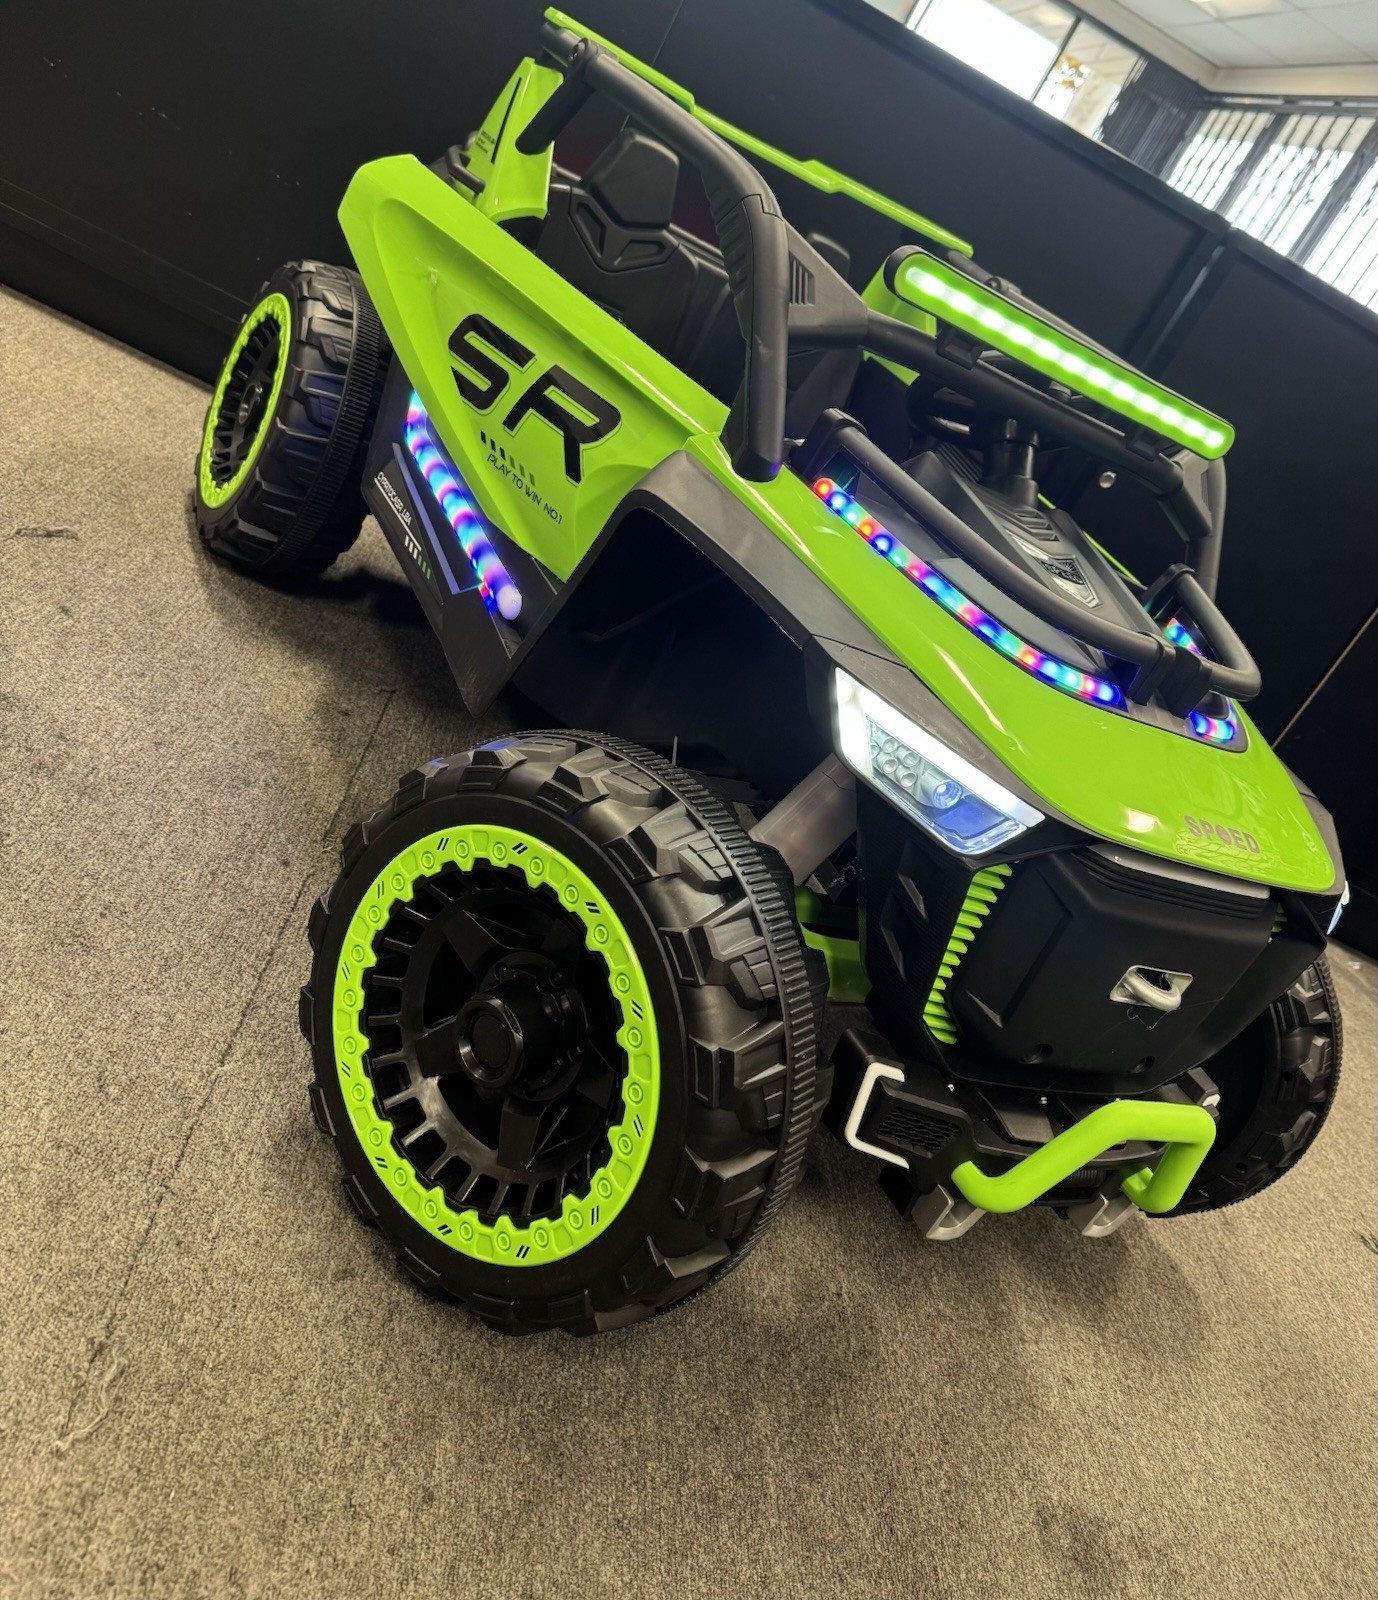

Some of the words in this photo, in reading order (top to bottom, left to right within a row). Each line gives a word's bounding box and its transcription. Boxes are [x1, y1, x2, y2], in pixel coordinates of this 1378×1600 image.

[448, 313, 621, 485] SR
[486, 453, 511, 478] PLAY
[510, 472, 524, 490] TO
[525, 484, 542, 506] WIN
[544, 503, 563, 524] NO.1
